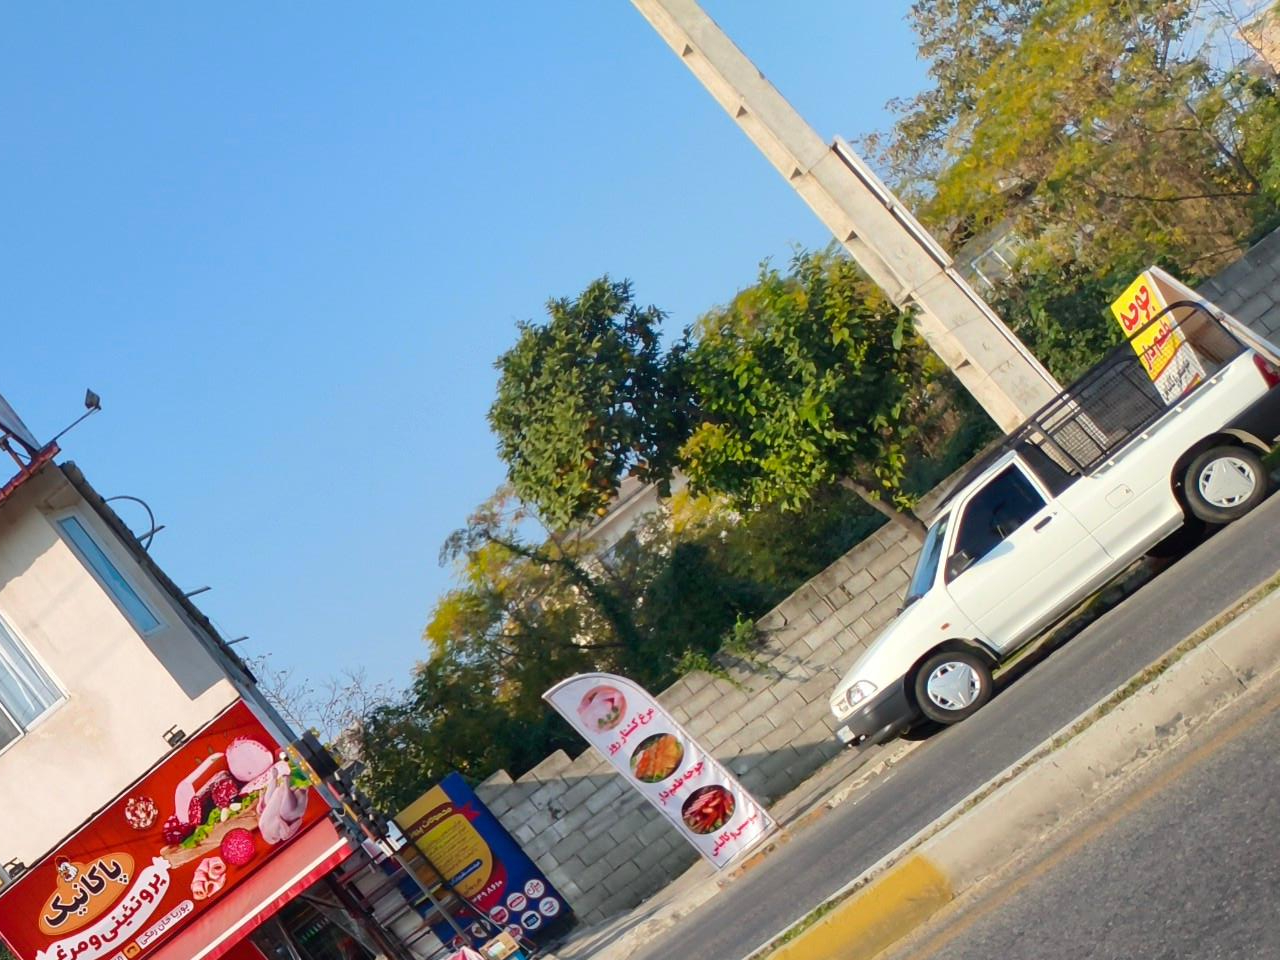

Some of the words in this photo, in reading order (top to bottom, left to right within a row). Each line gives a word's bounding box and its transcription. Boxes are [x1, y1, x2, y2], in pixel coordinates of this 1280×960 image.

[1119, 285, 1155, 331] جوجه
[638, 707, 656, 726] مرغ
[41, 853, 126, 928] پاکانیک
[100, 869, 166, 946] پروتئینی
